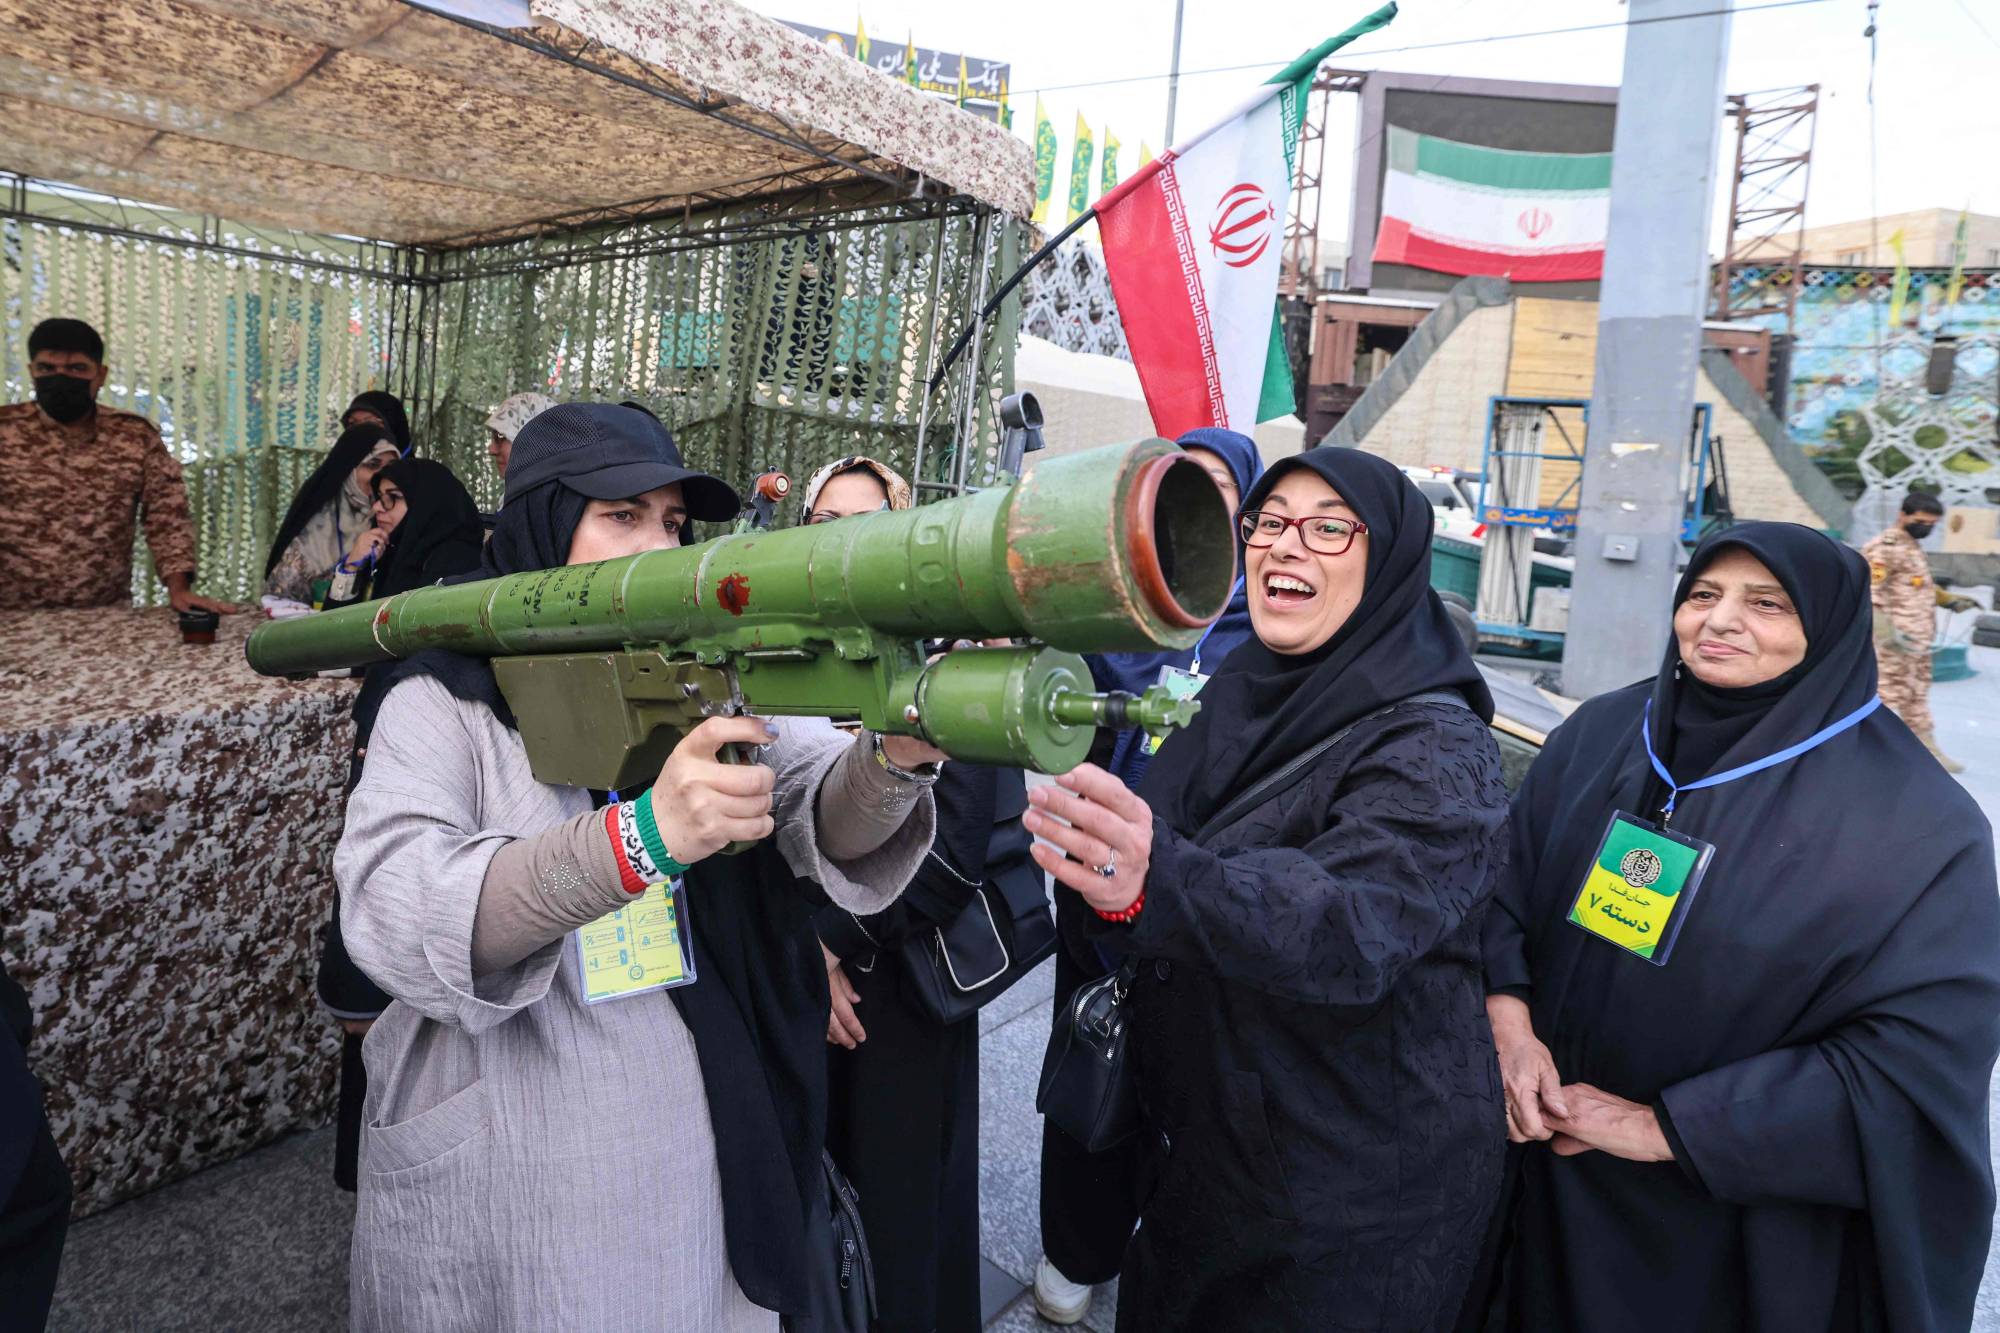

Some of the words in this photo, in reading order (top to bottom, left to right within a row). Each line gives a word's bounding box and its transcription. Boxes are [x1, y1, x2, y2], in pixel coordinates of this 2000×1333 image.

[919, 80, 956, 96] MELL
[1589, 892, 1603, 909] ۷
[1601, 903, 1650, 933] دسته
